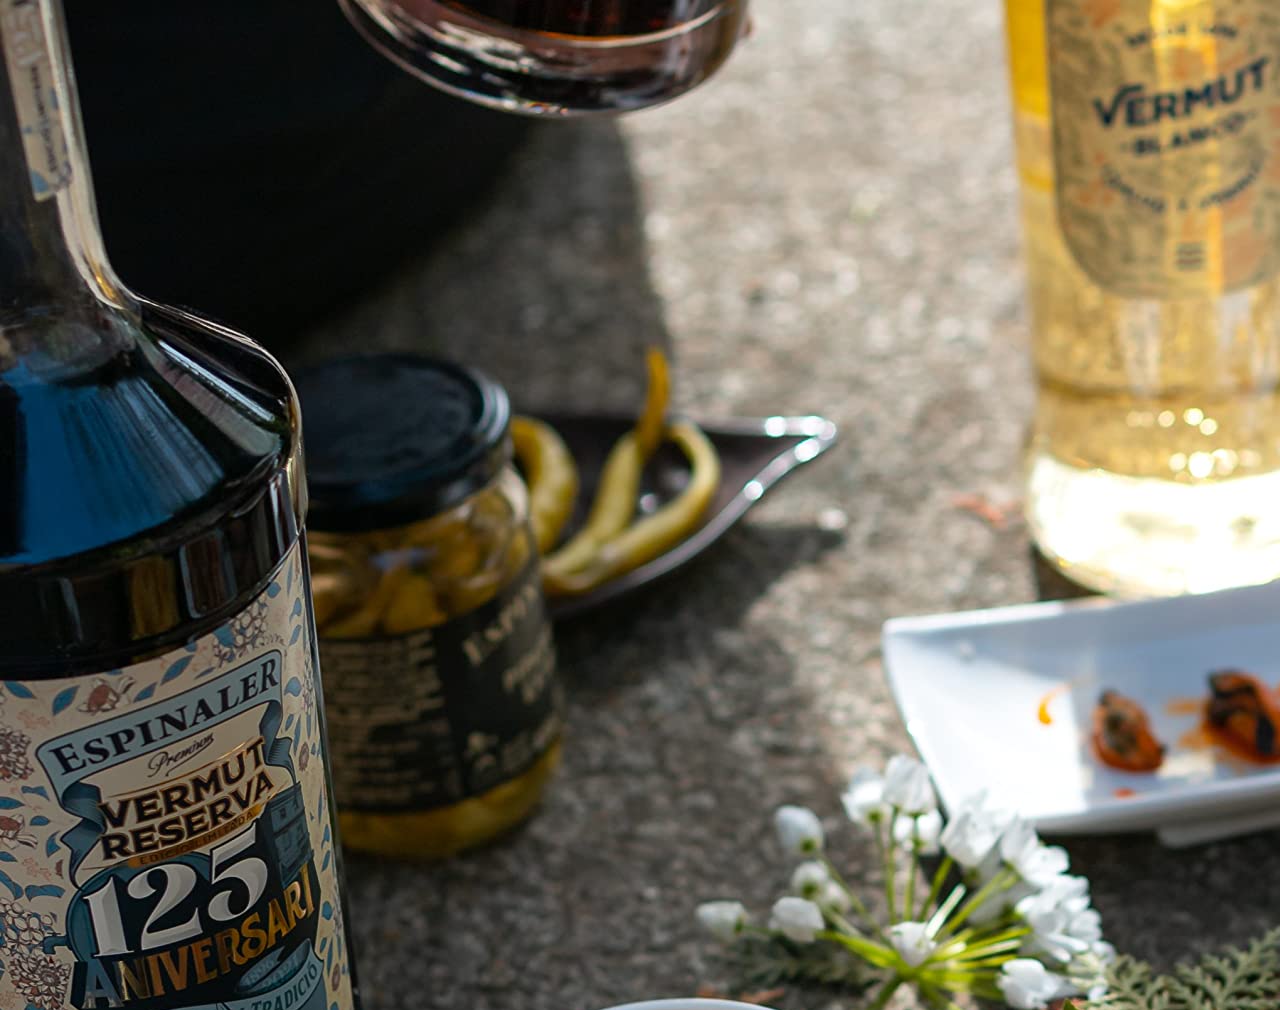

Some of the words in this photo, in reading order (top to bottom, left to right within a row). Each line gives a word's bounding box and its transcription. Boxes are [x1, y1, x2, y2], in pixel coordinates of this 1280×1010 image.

[1092, 56, 1270, 128] VERMUT
[51, 658, 280, 776] ESPINALER
[147, 732, 215, 778] Premium
[100, 736, 266, 830] VERMUT
[100, 767, 276, 861] RESERVA
[82, 818, 268, 958] 125
[81, 862, 315, 1010] ANIVERSARI
